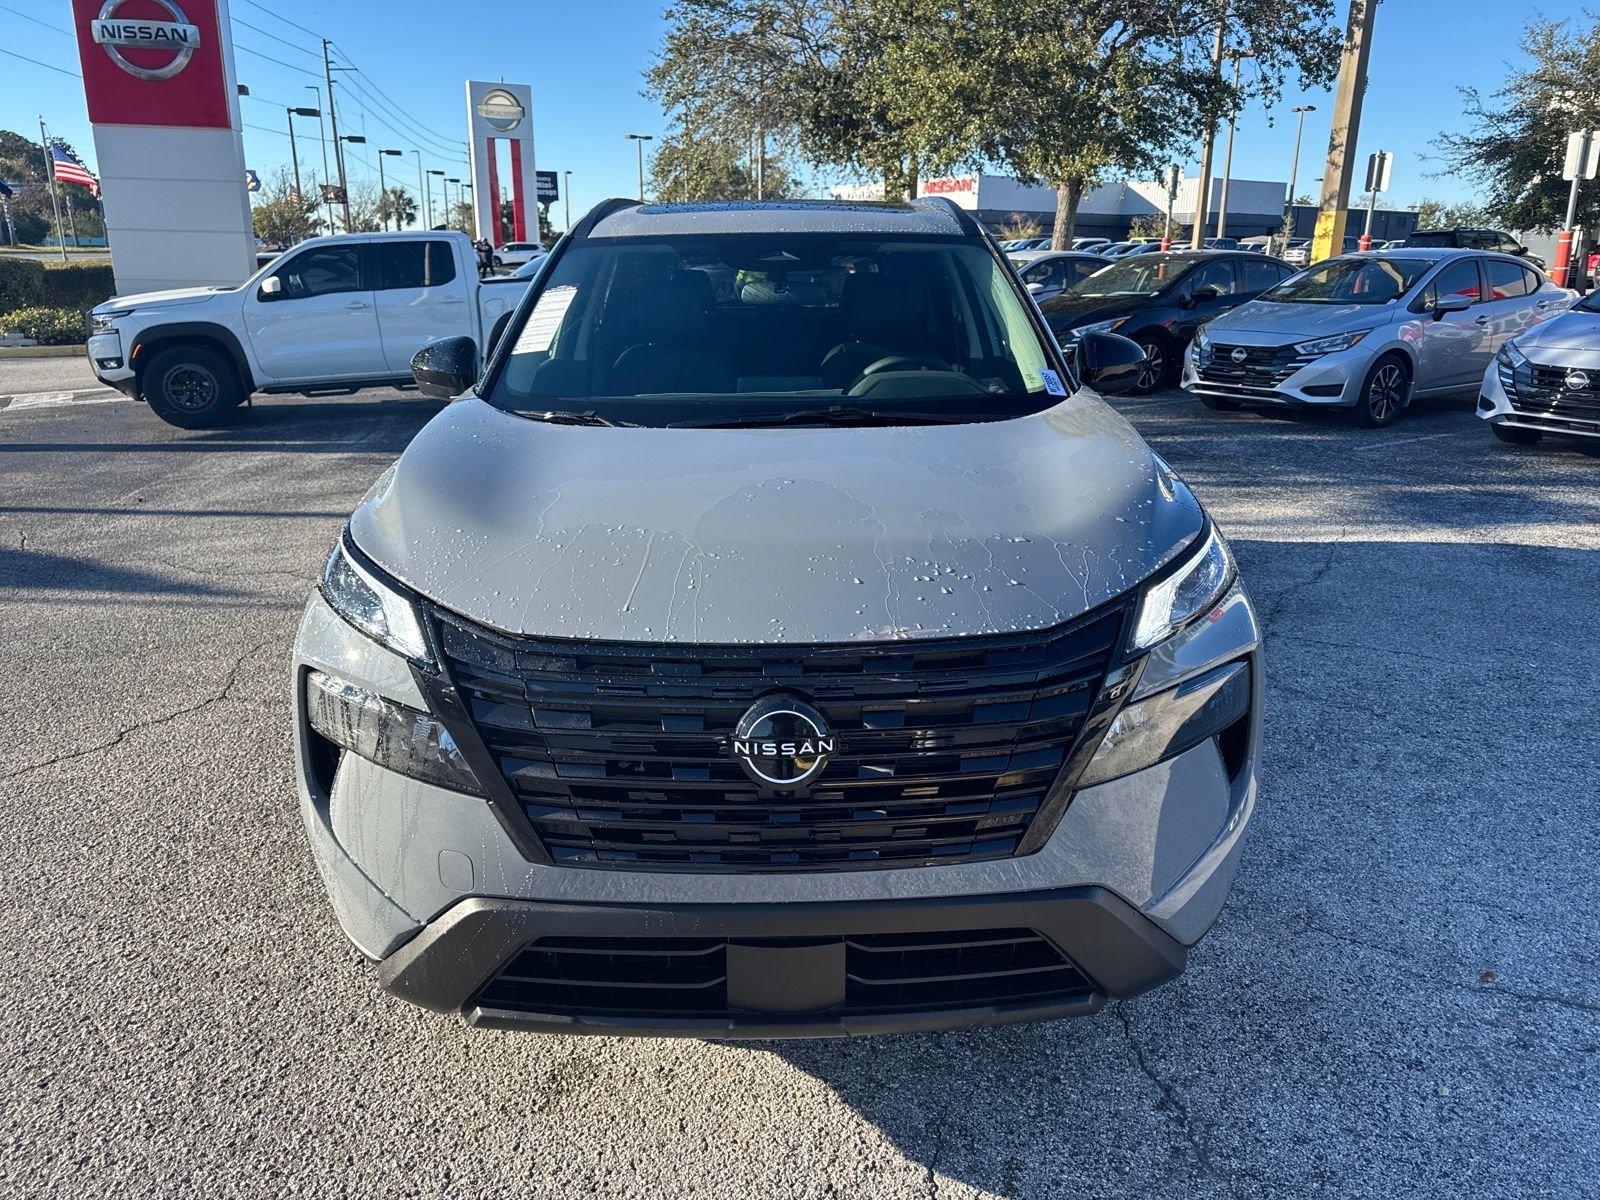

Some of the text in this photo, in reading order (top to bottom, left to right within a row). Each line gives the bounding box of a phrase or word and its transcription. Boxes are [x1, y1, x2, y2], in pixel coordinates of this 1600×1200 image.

[101, 25, 188, 42] NISSAN
[925, 178, 972, 193] NISSAN
[734, 739, 834, 756] NISSAN
